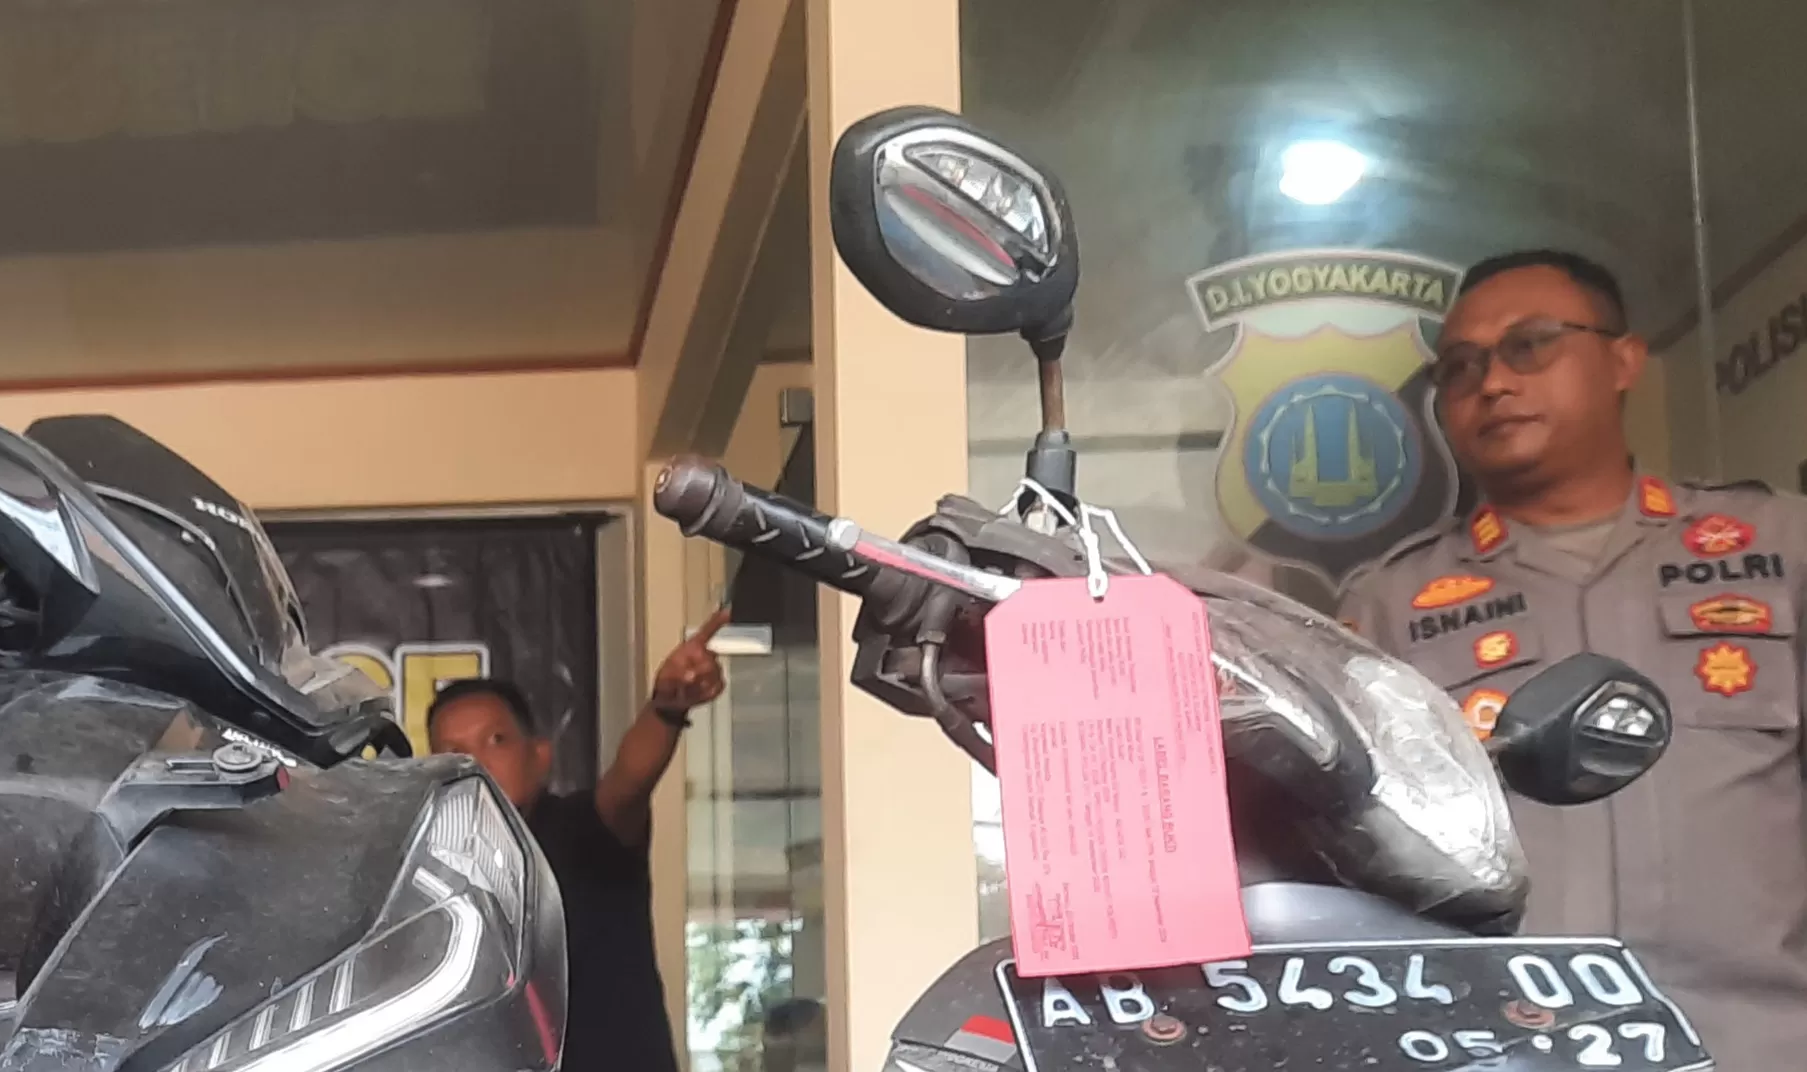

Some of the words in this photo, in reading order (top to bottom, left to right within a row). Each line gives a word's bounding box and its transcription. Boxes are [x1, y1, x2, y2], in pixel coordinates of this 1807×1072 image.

[1659, 554, 1784, 587] POLRI
[1409, 592, 1527, 642] ISNAINI
[1043, 970, 1155, 1028] AB
[1201, 954, 1454, 1013] 5434
